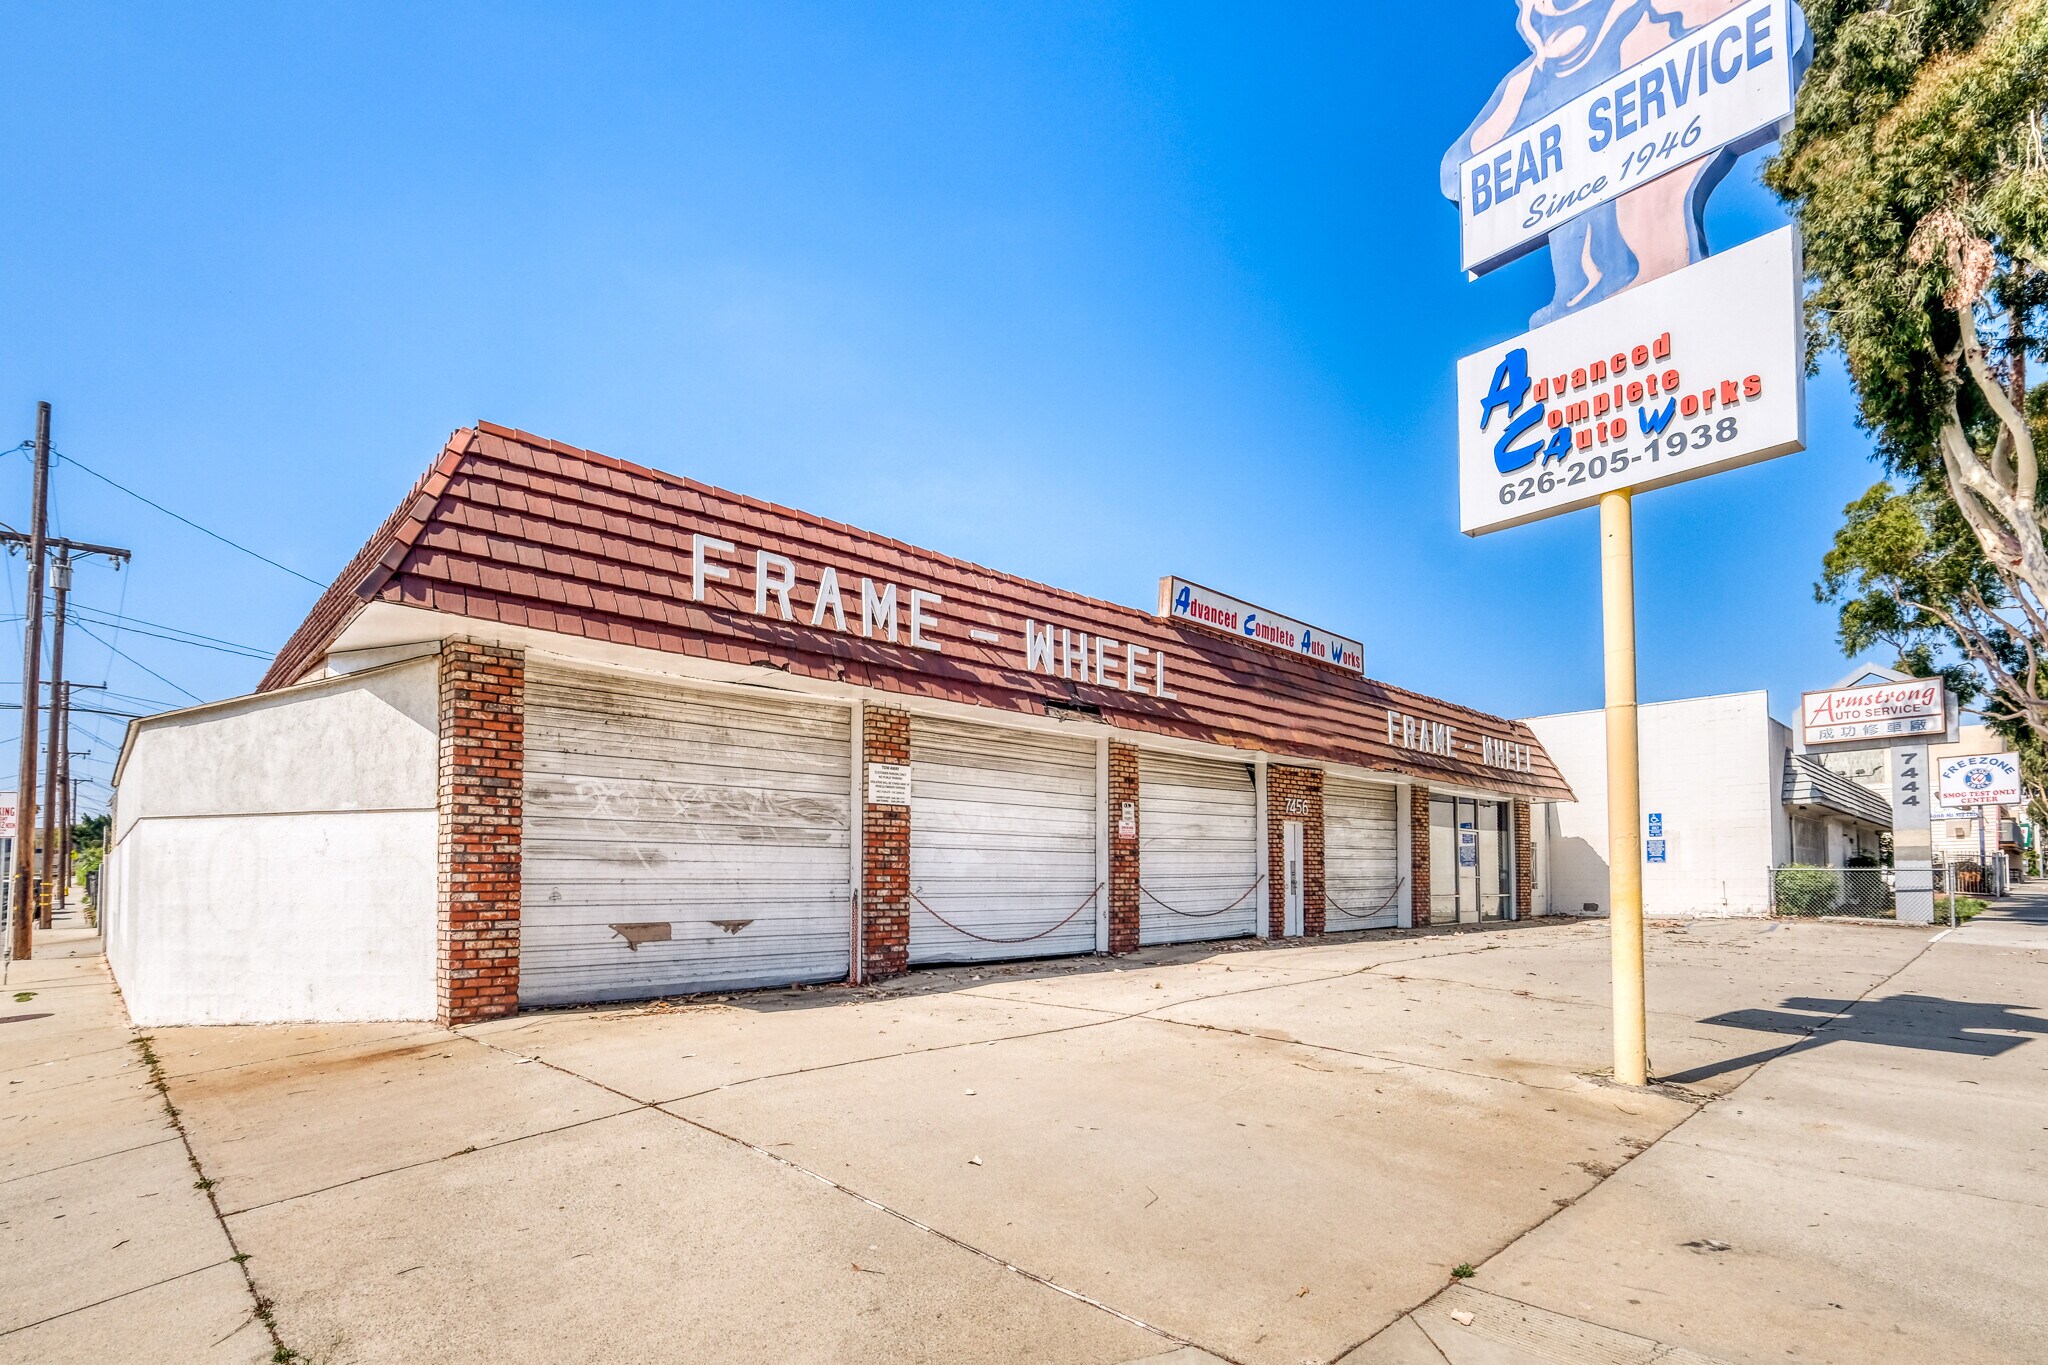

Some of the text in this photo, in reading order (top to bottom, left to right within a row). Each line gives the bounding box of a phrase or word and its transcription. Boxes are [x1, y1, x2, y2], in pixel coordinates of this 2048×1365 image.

[1471, 4, 1773, 216] BEAR SERVICE
[1523, 115, 1701, 229] Since 1946
[1480, 331, 1671, 429] Advanced
[1494, 369, 1680, 473] Complete
[1542, 374, 1762, 466] Auto Works
[1499, 416, 1738, 505] 626-205-1938
[692, 533, 941, 651] FRAME
[1026, 619, 1178, 700] WHEEL
[1174, 586, 1360, 669] Advanced Complete Auto Works
[1388, 710, 1457, 758] FRAME
[1482, 735, 1531, 772] WHEEL
[1810, 687, 1935, 724] Armstrong
[1865, 704, 1921, 717] SERVICE
[1284, 798, 1309, 815] 7456
[1901, 753, 1920, 806] 7444
[1942, 757, 2015, 779] FREEZONE
